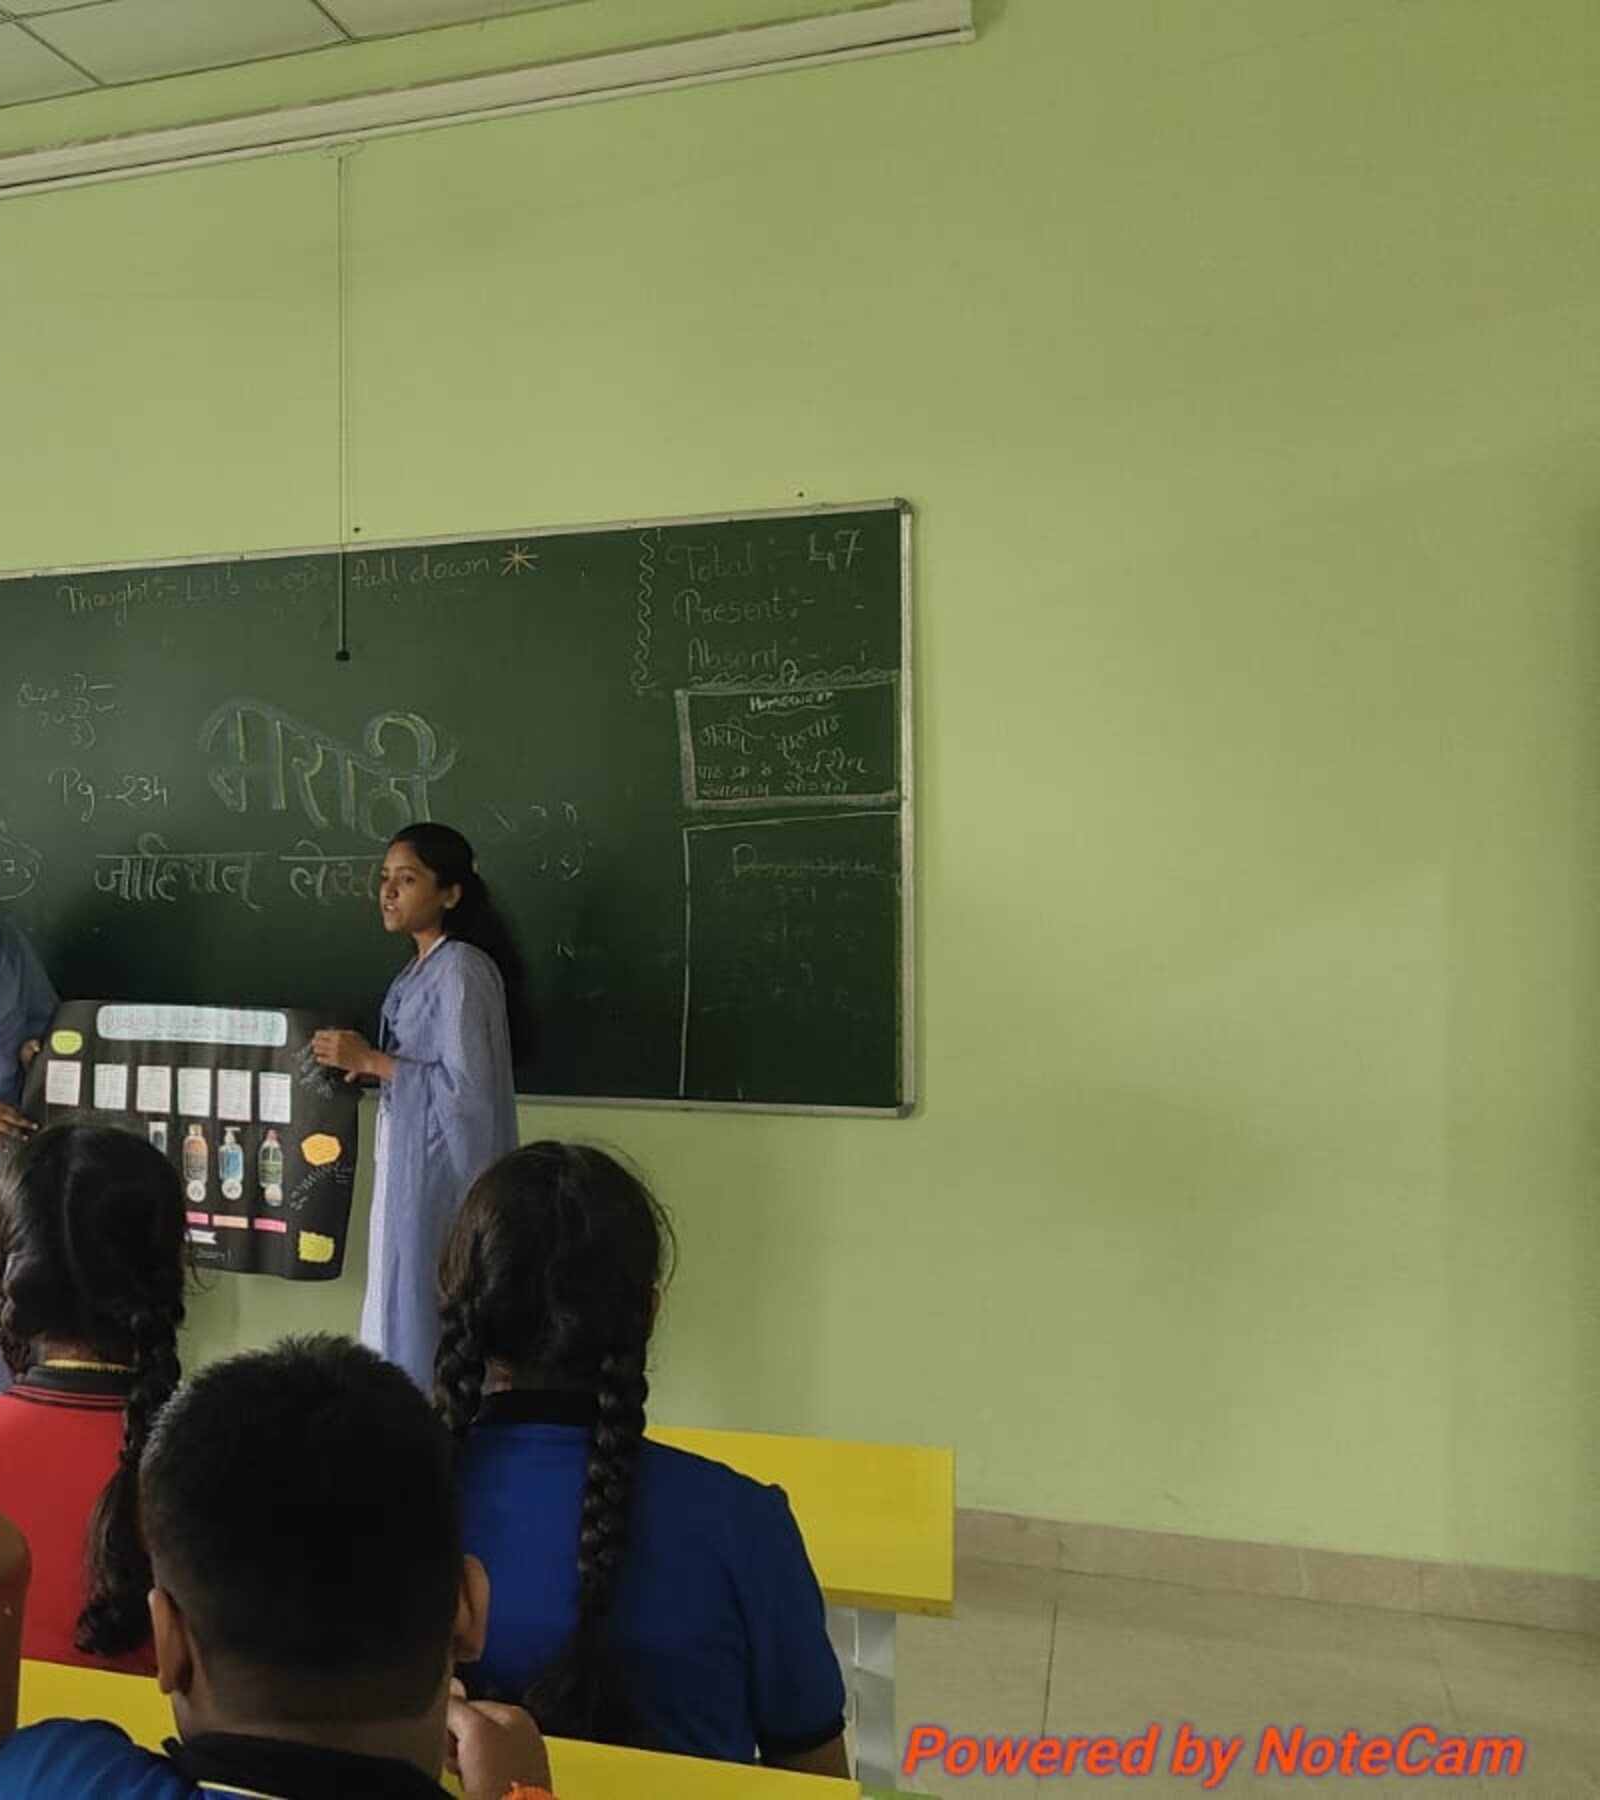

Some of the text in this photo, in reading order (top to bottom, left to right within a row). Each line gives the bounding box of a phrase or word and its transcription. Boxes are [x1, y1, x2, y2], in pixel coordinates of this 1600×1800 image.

[807, 528, 865, 573] 47
[351, 556, 399, 592] fall
[409, 552, 489, 583] down
